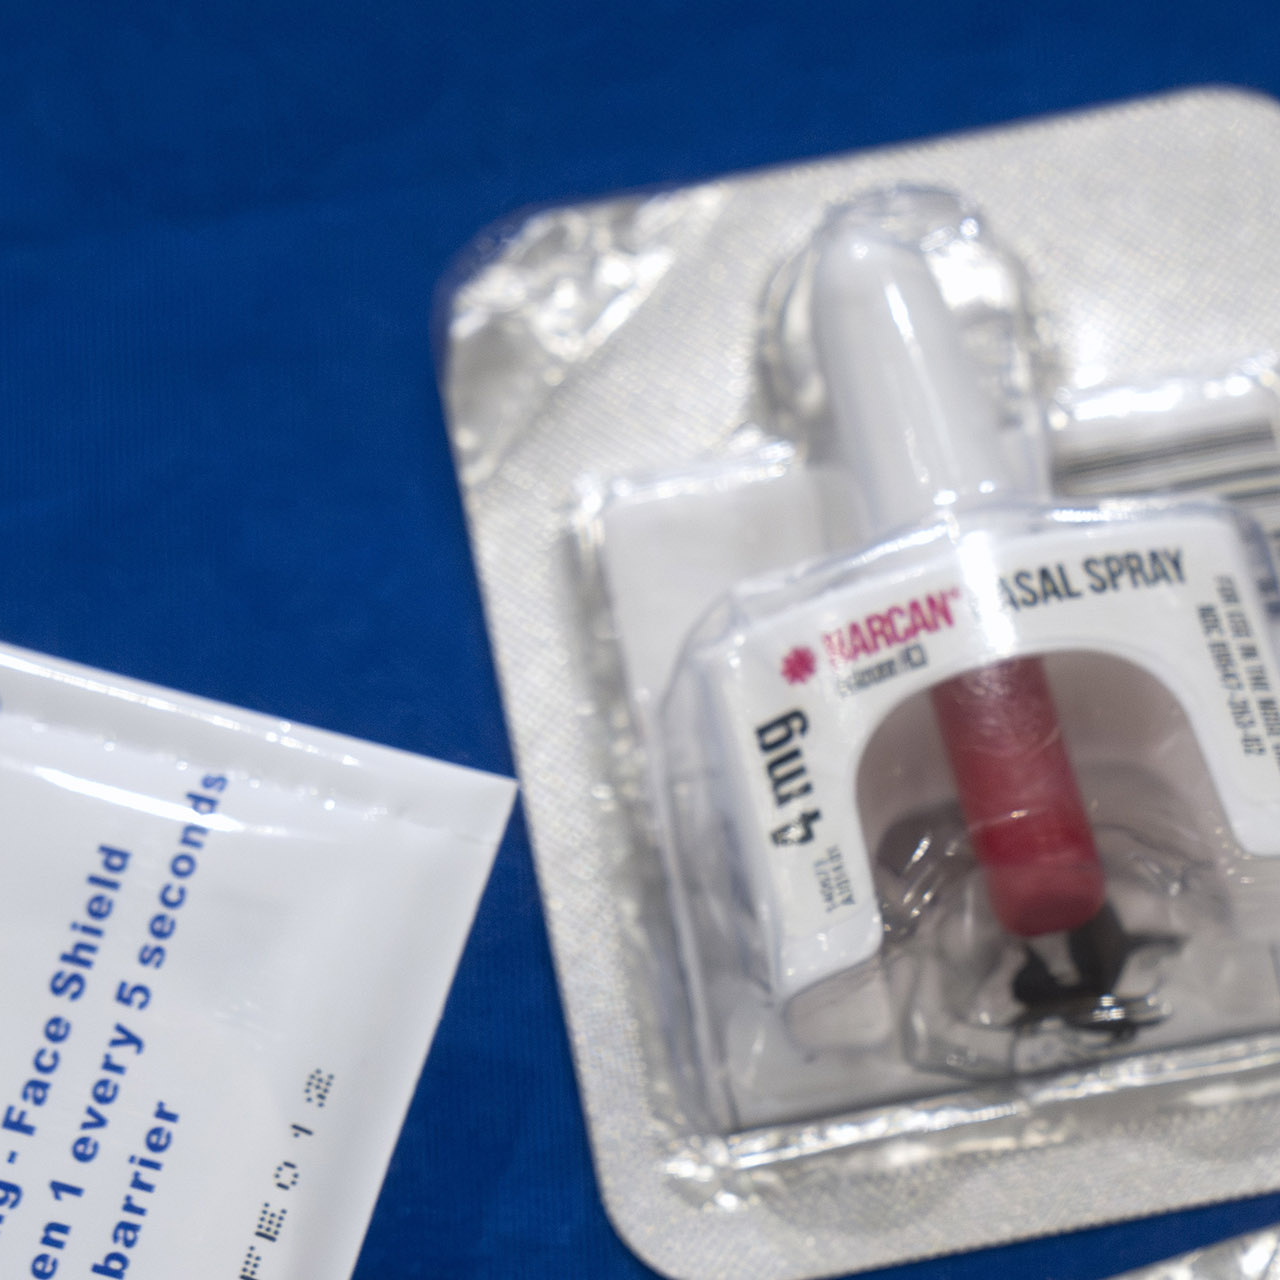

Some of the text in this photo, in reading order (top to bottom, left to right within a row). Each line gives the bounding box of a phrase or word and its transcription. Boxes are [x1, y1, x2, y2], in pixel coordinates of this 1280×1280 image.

[1082, 547, 1187, 597] SPRAY
[754, 708, 813, 808] mg
[2, 1013, 72, 1137] Face
[49, 844, 132, 1002] Shield
[49, 1178, 85, 1201] 1
[70, 1020, 147, 1166] every
[117, 981, 152, 1010] 5
[136, 771, 229, 971] seconds
